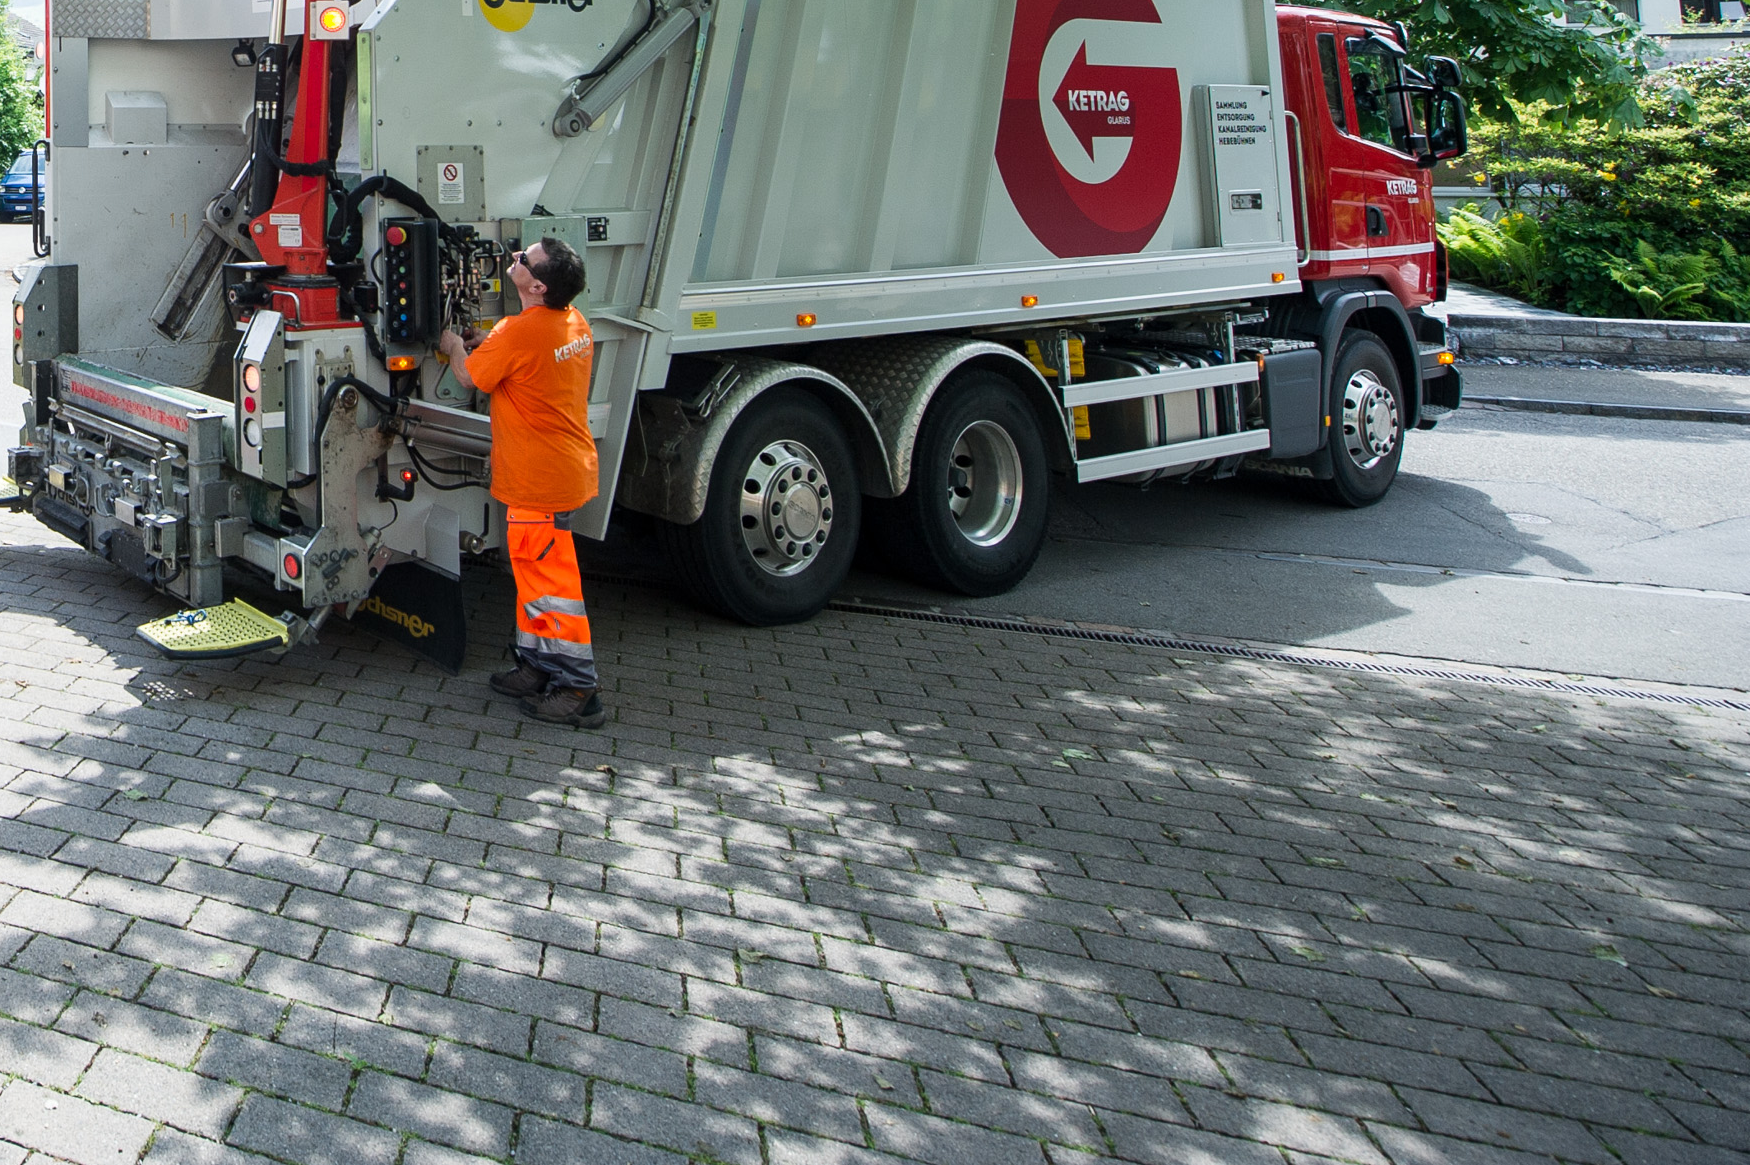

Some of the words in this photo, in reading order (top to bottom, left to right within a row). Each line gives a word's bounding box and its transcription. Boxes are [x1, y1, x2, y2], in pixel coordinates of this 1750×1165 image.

[1068, 89, 1130, 112] KETRAG
[1215, 101, 1248, 109] SAMMLUNG
[1107, 116, 1131, 124] GLARUS
[1217, 113, 1255, 121] ENTSORGUNG
[1386, 180, 1417, 195] KETRAG
[554, 333, 591, 363] KETRAG
